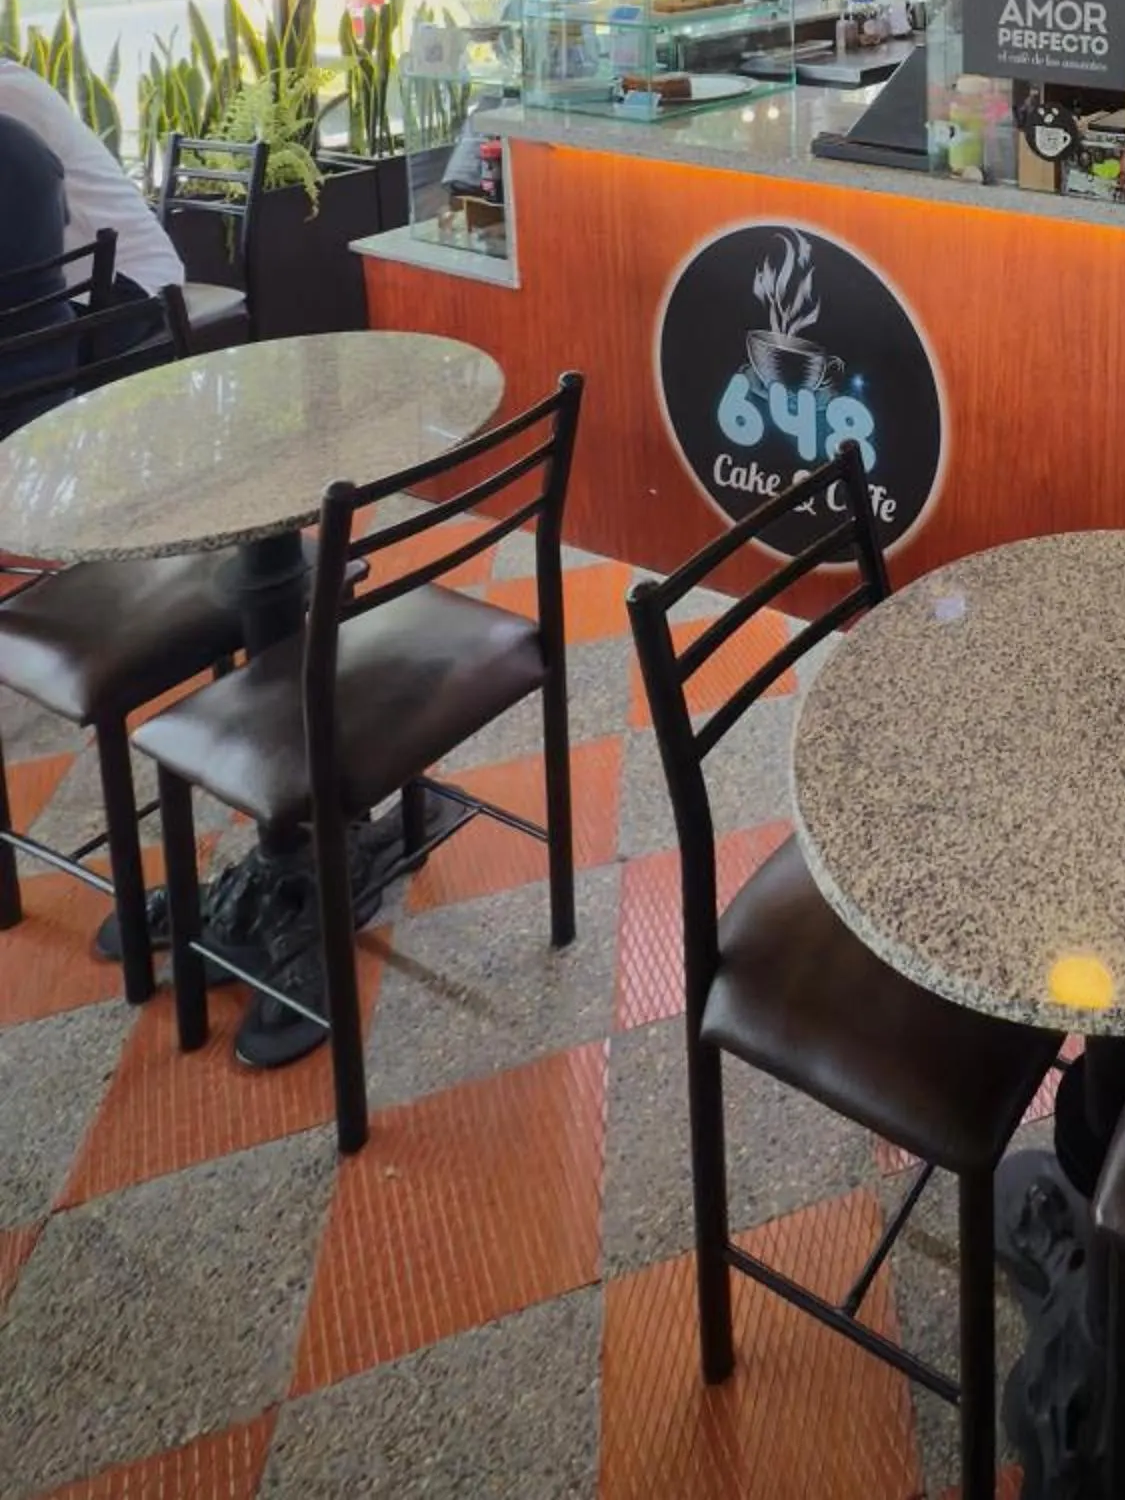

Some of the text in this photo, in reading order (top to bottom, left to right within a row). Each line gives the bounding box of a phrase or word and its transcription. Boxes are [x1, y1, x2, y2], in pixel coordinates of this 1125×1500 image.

[998, 27, 1109, 55] PERFECTO
[717, 372, 877, 474] 648
[715, 454, 781, 496] Cake
